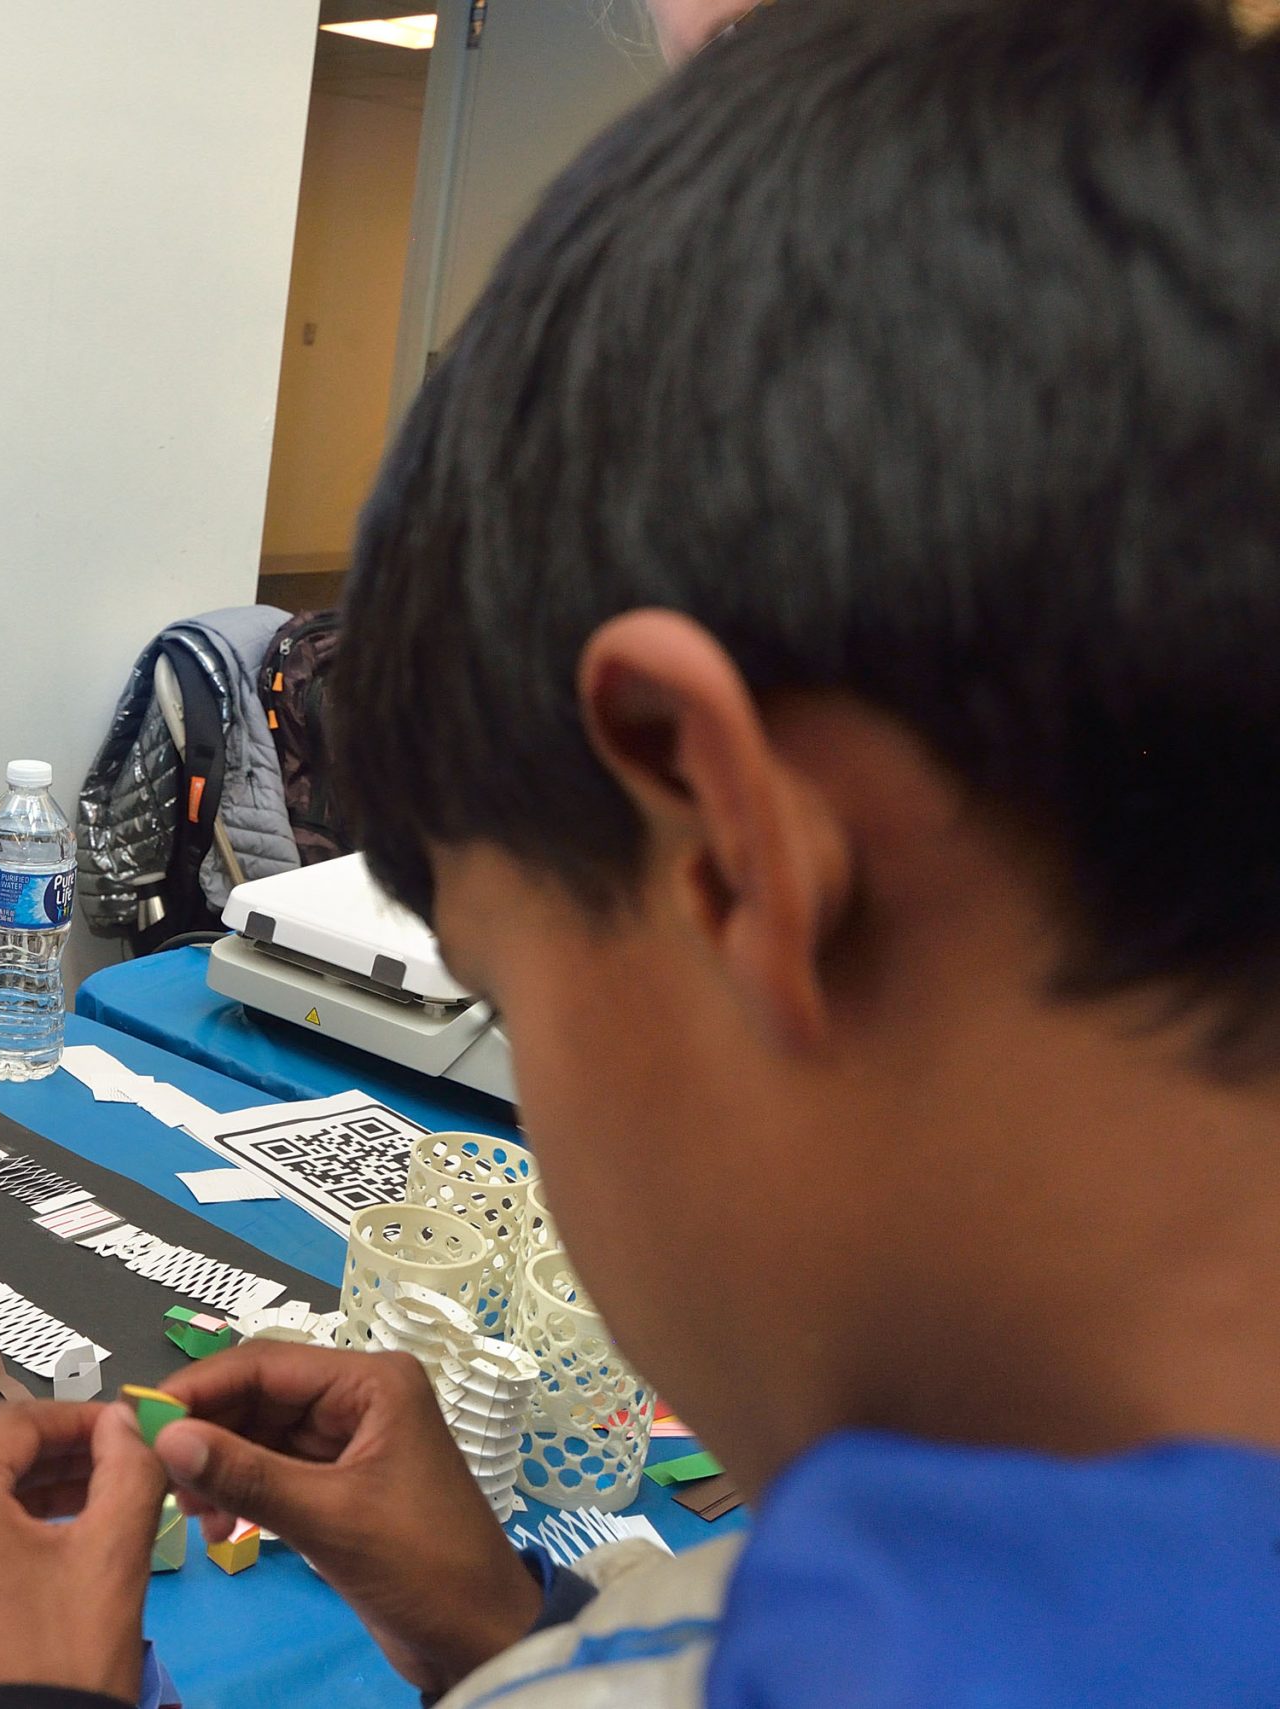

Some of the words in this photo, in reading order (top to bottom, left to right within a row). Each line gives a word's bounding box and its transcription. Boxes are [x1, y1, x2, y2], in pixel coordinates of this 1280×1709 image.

[1, 873, 30, 884] PURIFIED
[53, 872, 74, 890] Pure
[0, 881, 23, 891] WATER
[56, 887, 72, 907] Life
